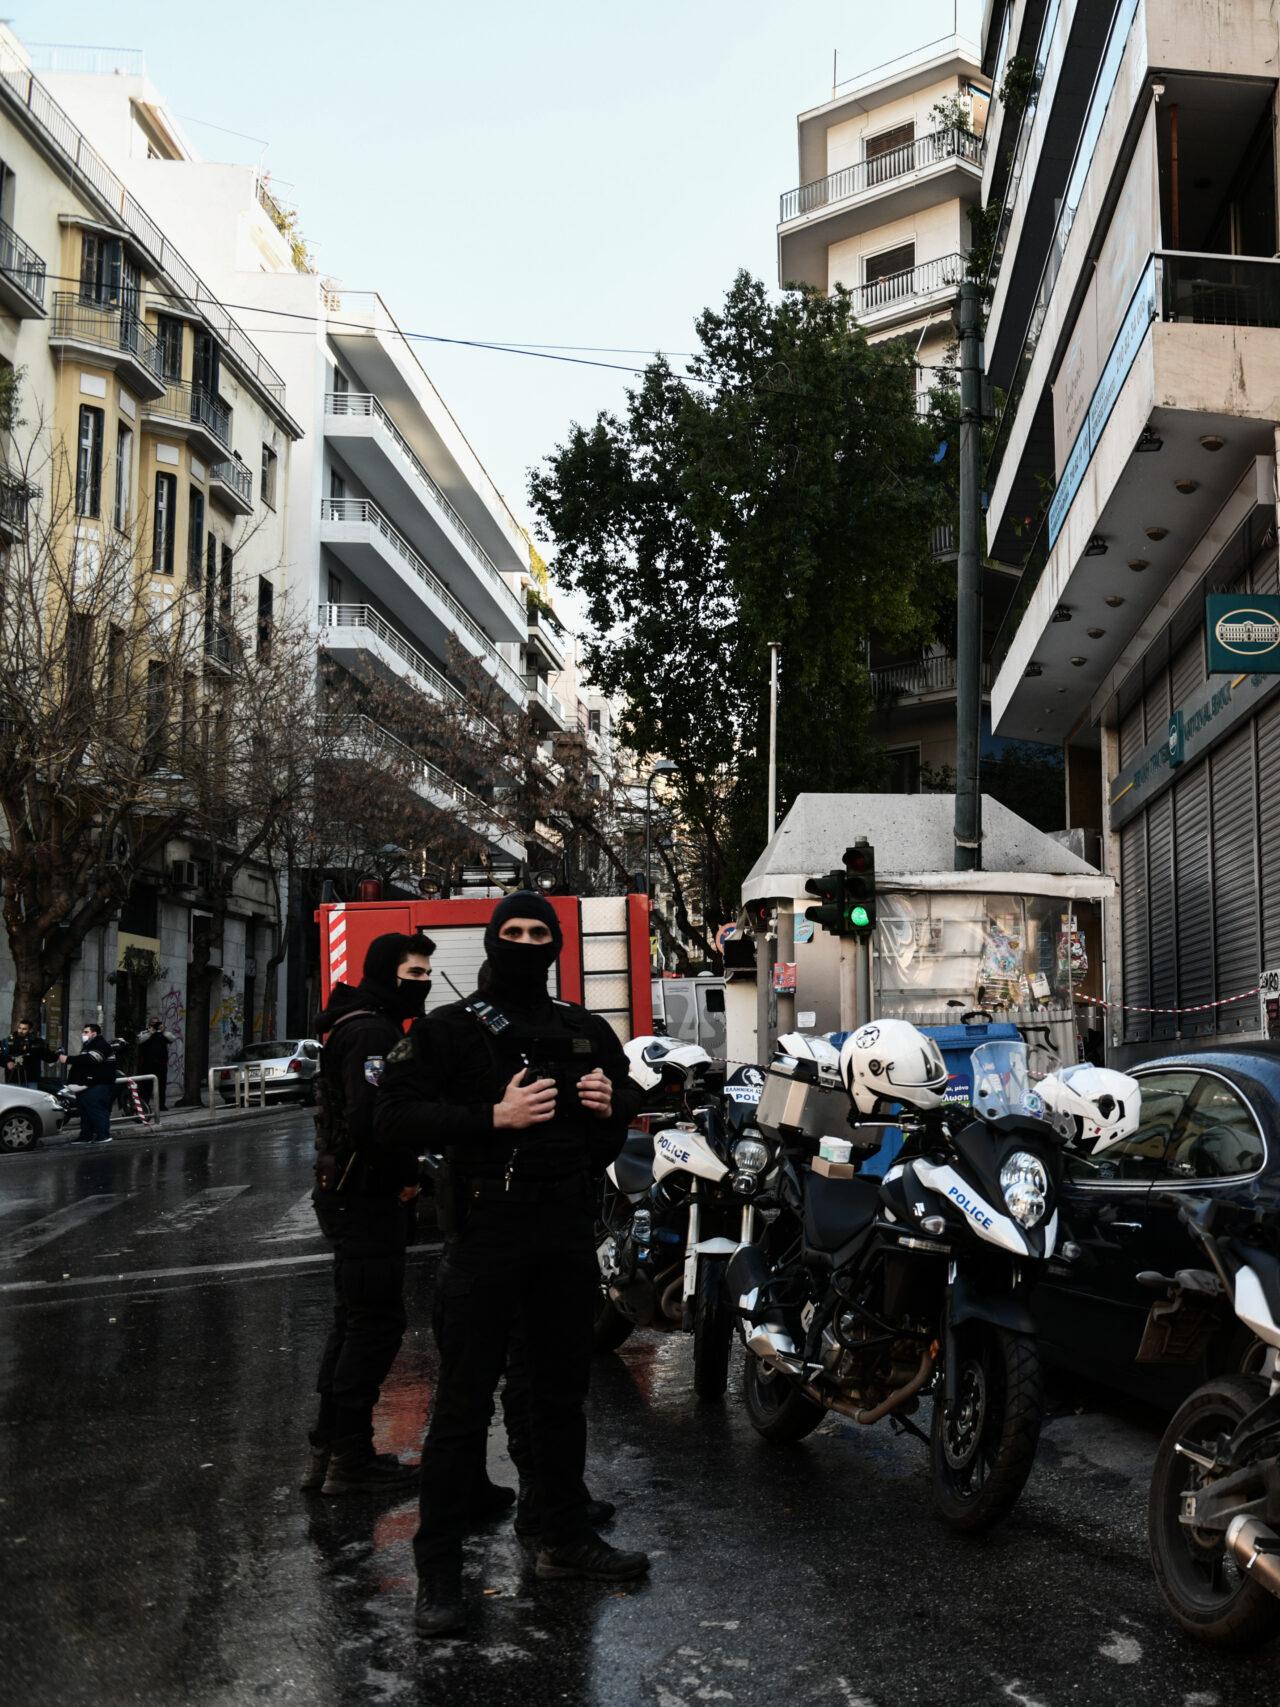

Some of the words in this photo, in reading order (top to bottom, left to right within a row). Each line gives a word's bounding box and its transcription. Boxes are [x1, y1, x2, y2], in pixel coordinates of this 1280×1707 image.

[736, 1093, 757, 1102] POL
[943, 1094, 969, 1102] λωση
[657, 1136, 690, 1163] POLICE
[948, 1186, 993, 1230] POLICE
